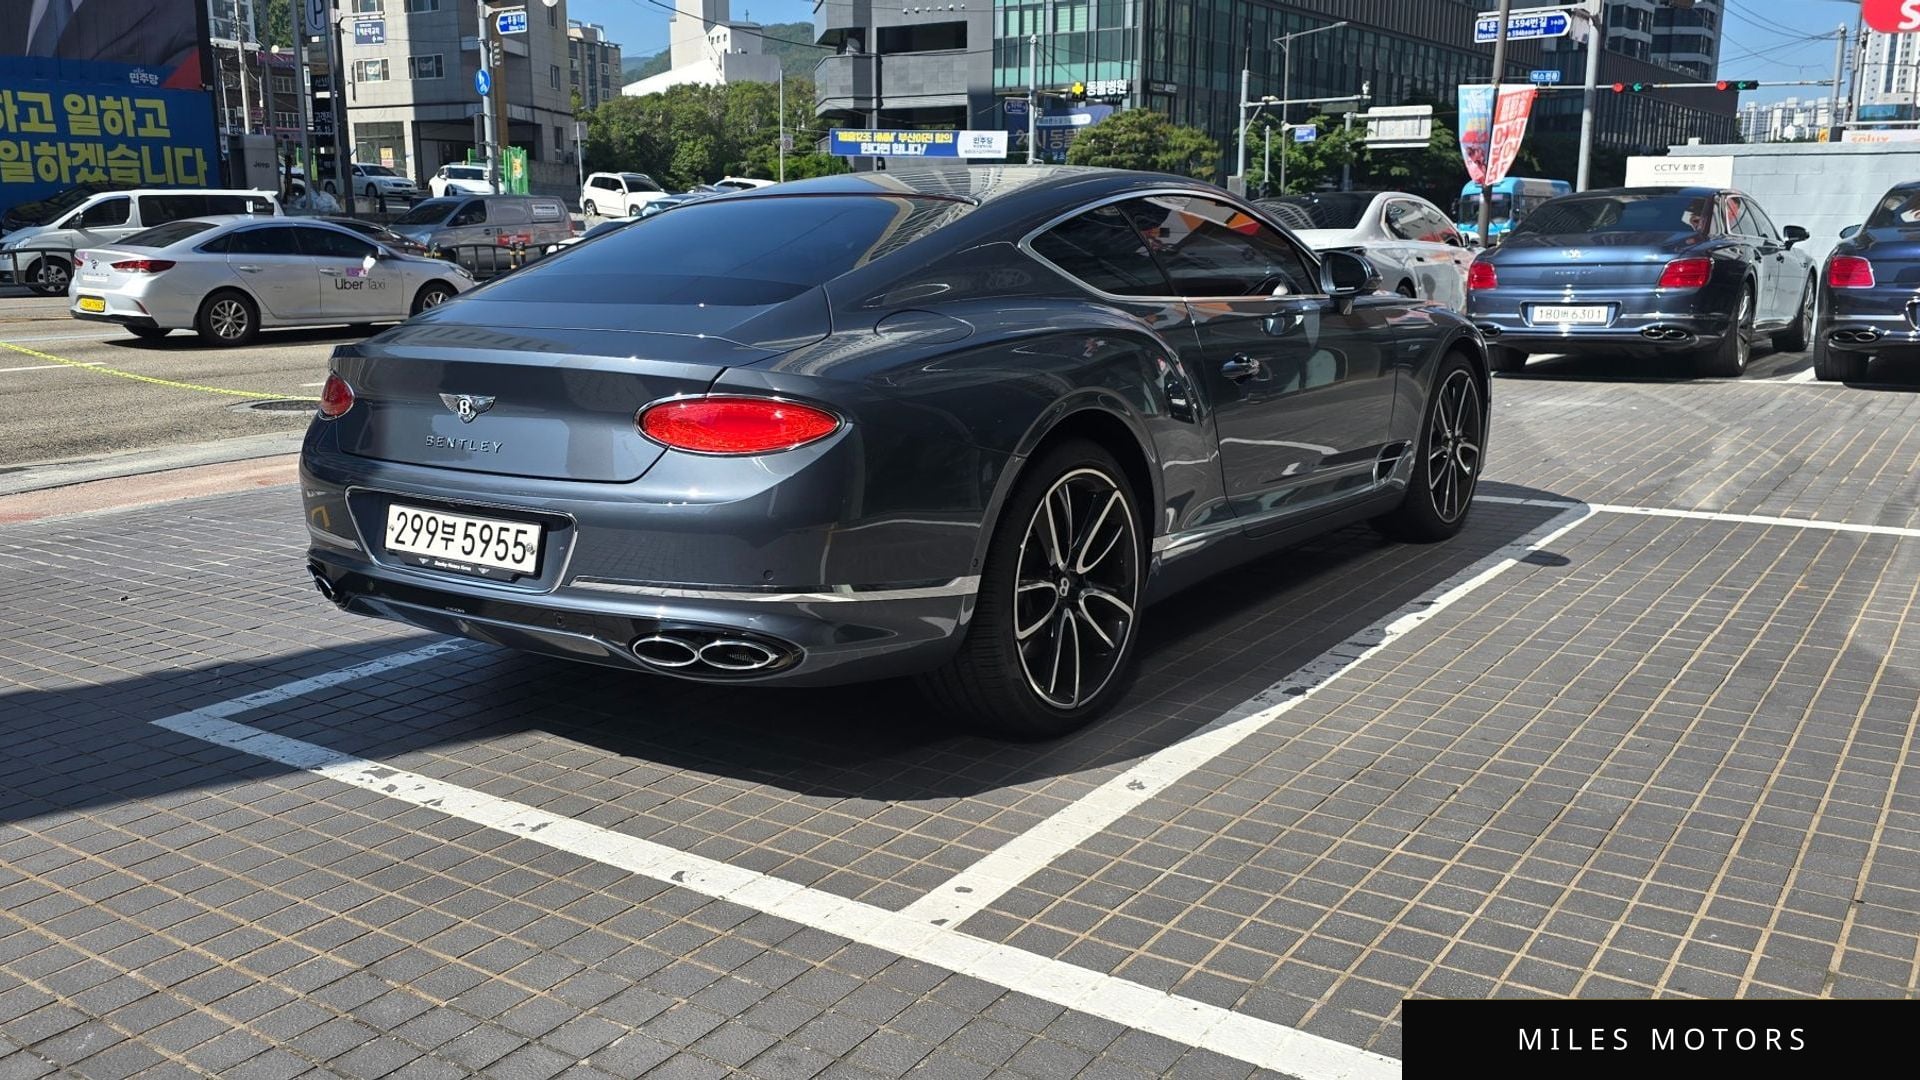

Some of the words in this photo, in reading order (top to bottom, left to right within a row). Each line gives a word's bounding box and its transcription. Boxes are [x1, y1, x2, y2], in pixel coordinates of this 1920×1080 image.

[1479, 17, 1547, 32] 해운로594번길
[129, 72, 160, 85] 민주당
[1086, 79, 1127, 96] 동물병원
[63, 93, 171, 138] 일하고
[0, 140, 208, 187] 일하겠습니다
[253, 161, 271, 169] Jeep
[1654, 163, 1681, 172] CCTV
[334, 278, 364, 290] Uber
[367, 278, 386, 289] Taxi
[425, 435, 503, 453] BENTLEY
